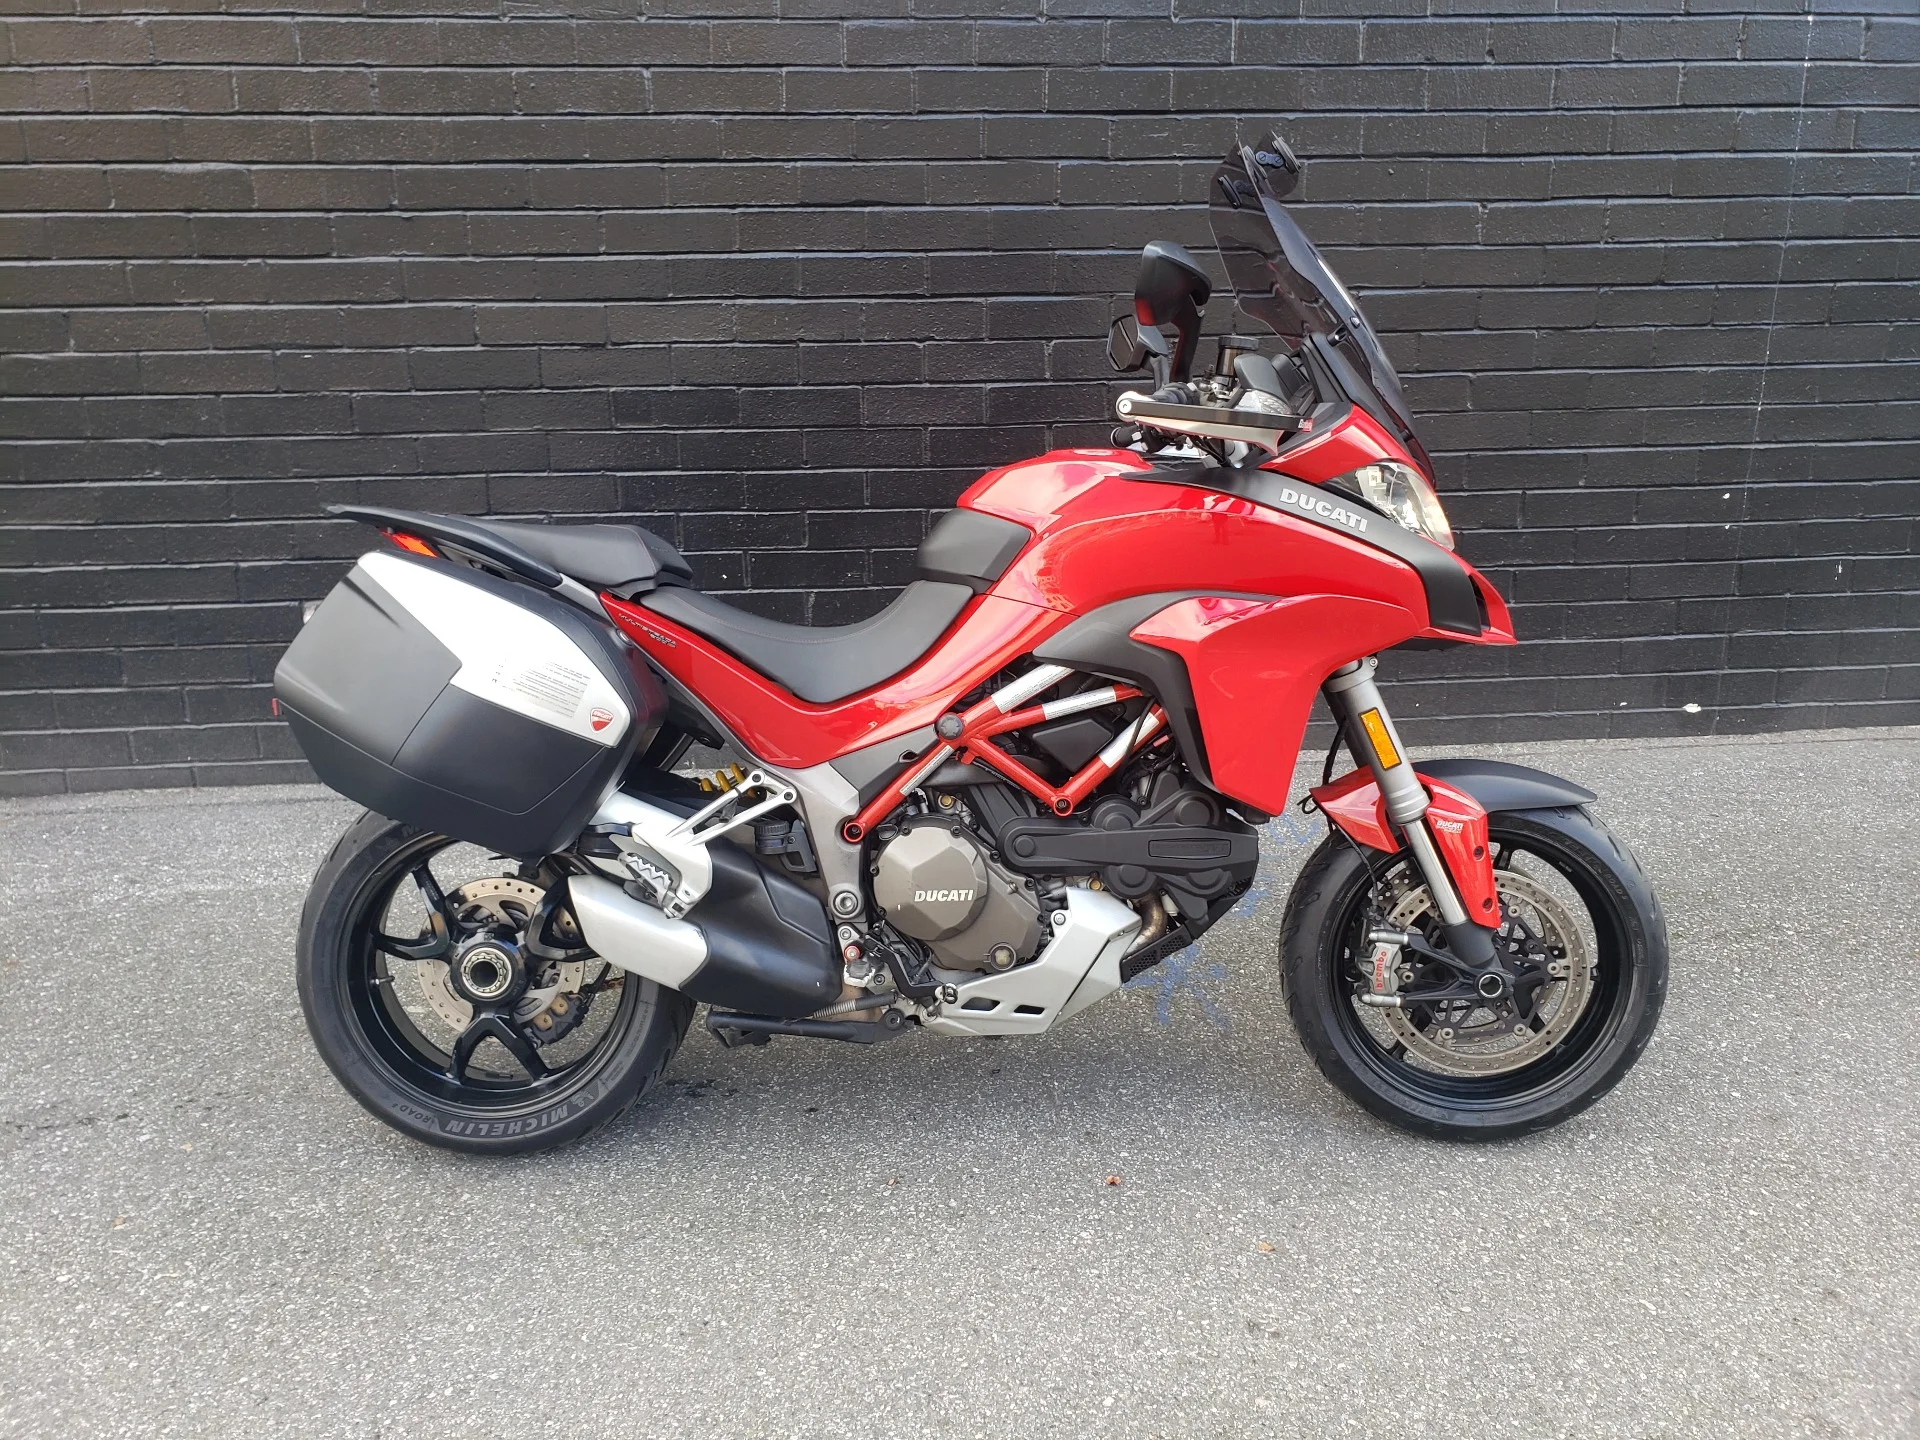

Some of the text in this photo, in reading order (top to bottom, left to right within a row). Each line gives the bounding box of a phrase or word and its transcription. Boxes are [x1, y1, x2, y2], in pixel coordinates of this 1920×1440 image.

[1280, 488, 1368, 532] DUCATI
[1436, 820, 1464, 830] DUCATI
[914, 889, 974, 902] DUCATI
[1376, 951, 1387, 990] brembo
[399, 1104, 432, 1124] ROAD
[445, 1105, 569, 1136] MICHELIN
